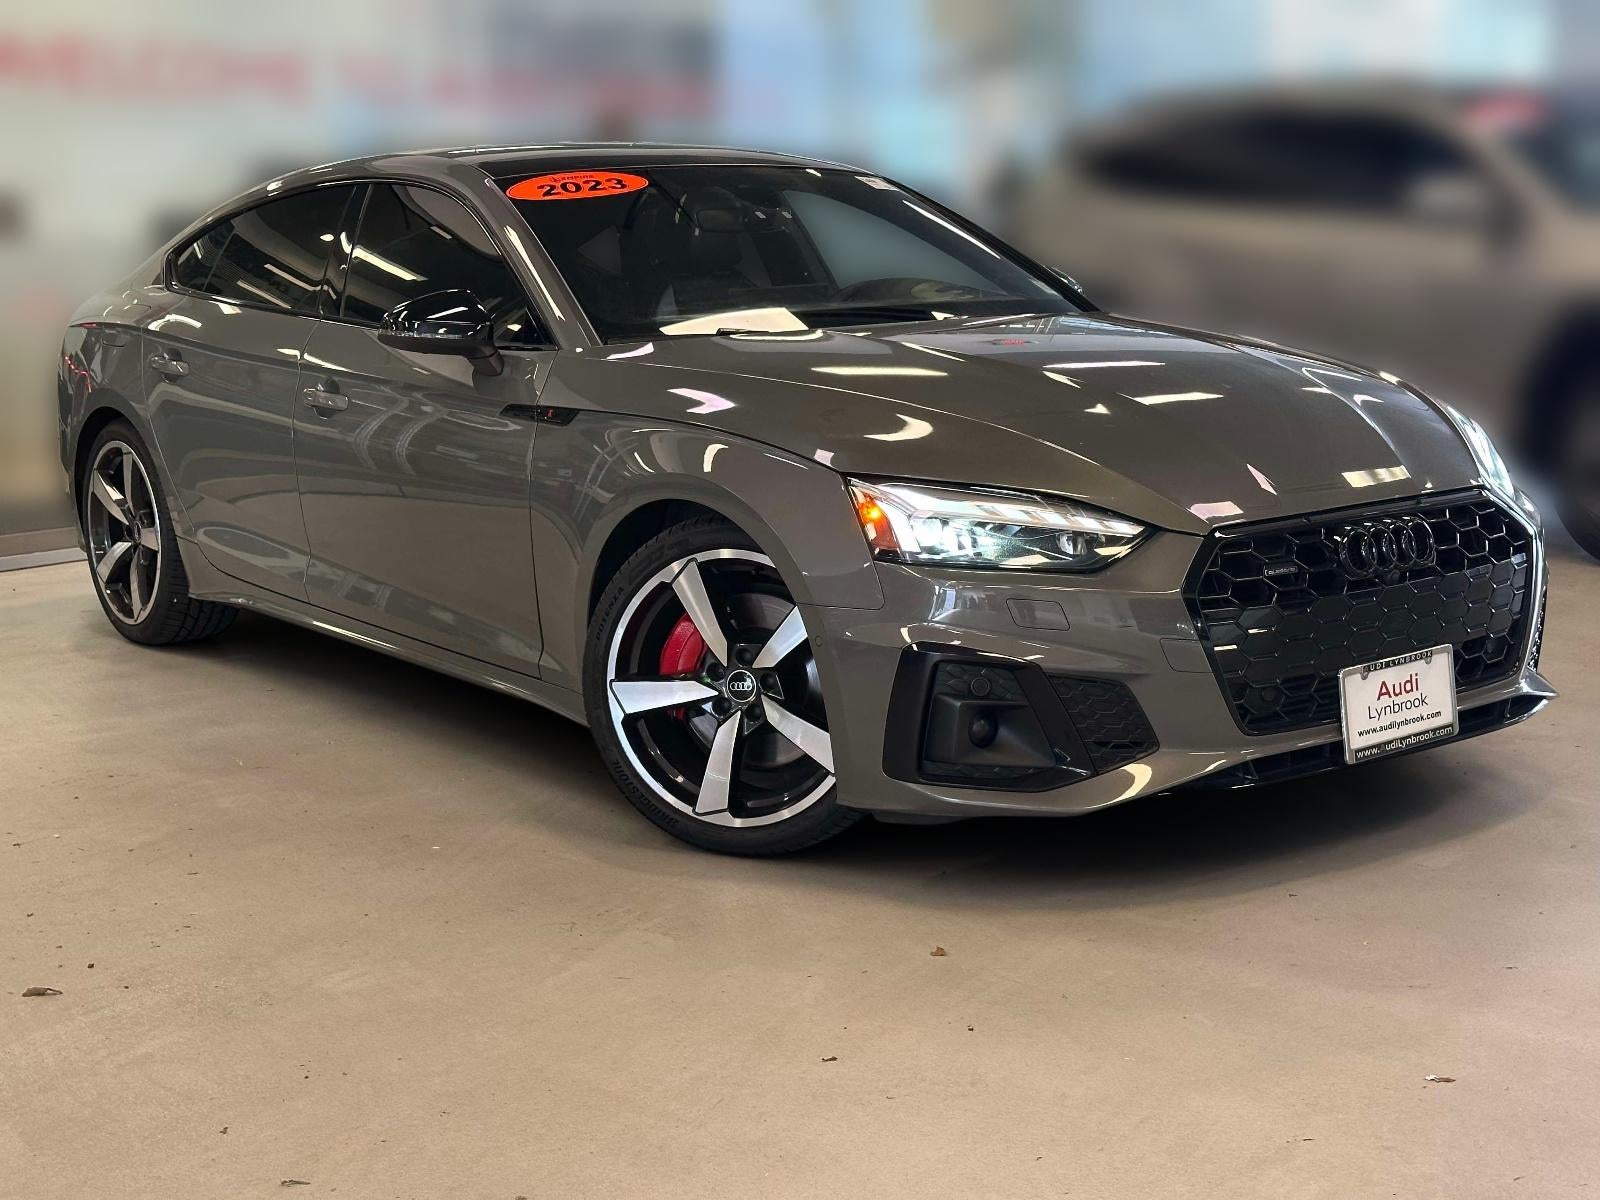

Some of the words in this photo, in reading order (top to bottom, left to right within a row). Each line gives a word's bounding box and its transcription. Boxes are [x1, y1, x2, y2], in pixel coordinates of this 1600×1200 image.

[536, 177, 628, 198] 2023
[1362, 661, 1387, 673] AUDI
[1389, 651, 1432, 667] LYNBROOK
[1376, 672, 1419, 701] Audi
[1367, 693, 1429, 721] Lynbrook
[1357, 710, 1442, 737] www.audilynbrook.com
[1356, 726, 1453, 759] www.AudiLynbrook.com
